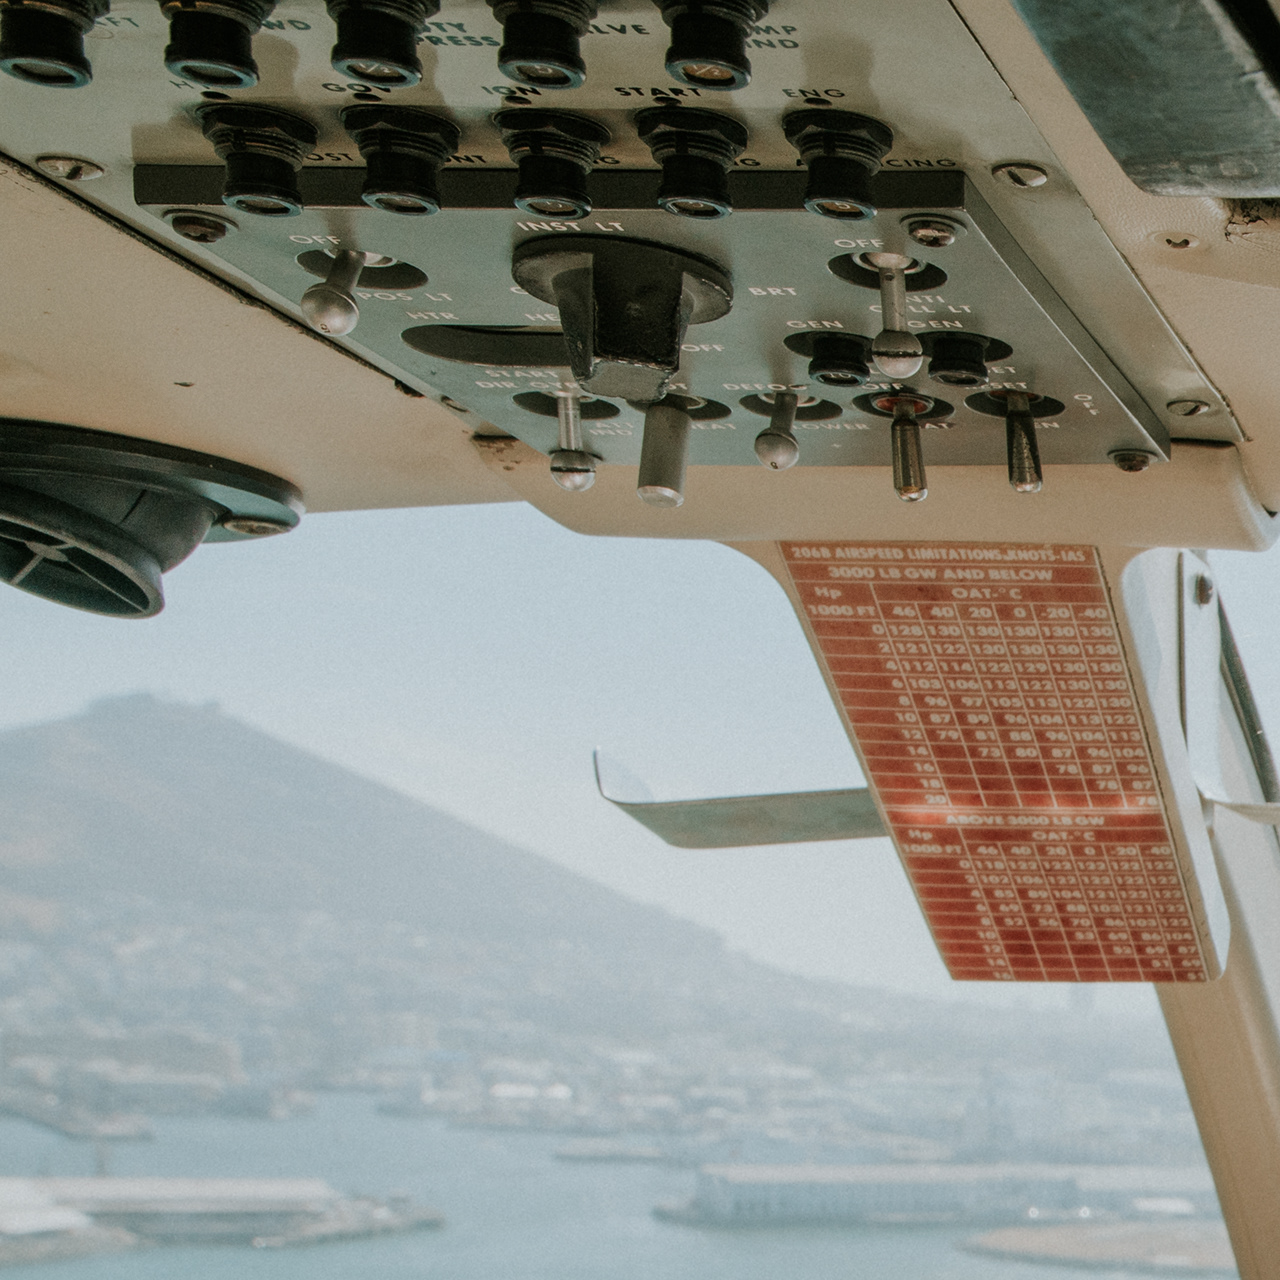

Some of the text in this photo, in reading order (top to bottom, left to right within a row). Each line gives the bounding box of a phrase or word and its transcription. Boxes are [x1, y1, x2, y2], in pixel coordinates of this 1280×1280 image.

[481, 85, 541, 95] IGN
[614, 87, 701, 97] START
[782, 88, 845, 98] ENG
[516, 221, 624, 232] INST LT
[289, 235, 341, 245] OFF
[834, 239, 884, 248] OFF
[748, 287, 798, 296] BRT
[356, 292, 453, 301] POS LT
[948, 305, 972, 313] LT
[406, 311, 459, 320] HTR
[786, 320, 844, 329] GEN
[907, 320, 963, 328] GEN
[681, 344, 725, 352] OFF
[485, 370, 558, 378] START
[475, 381, 518, 389] DIR
[861, 383, 903, 391] OFF
[835, 547, 903, 560] AIRSPEED
[829, 567, 1053, 581] 3000 LB GW AND BELOW
[1013, 607, 1026, 617] 0
